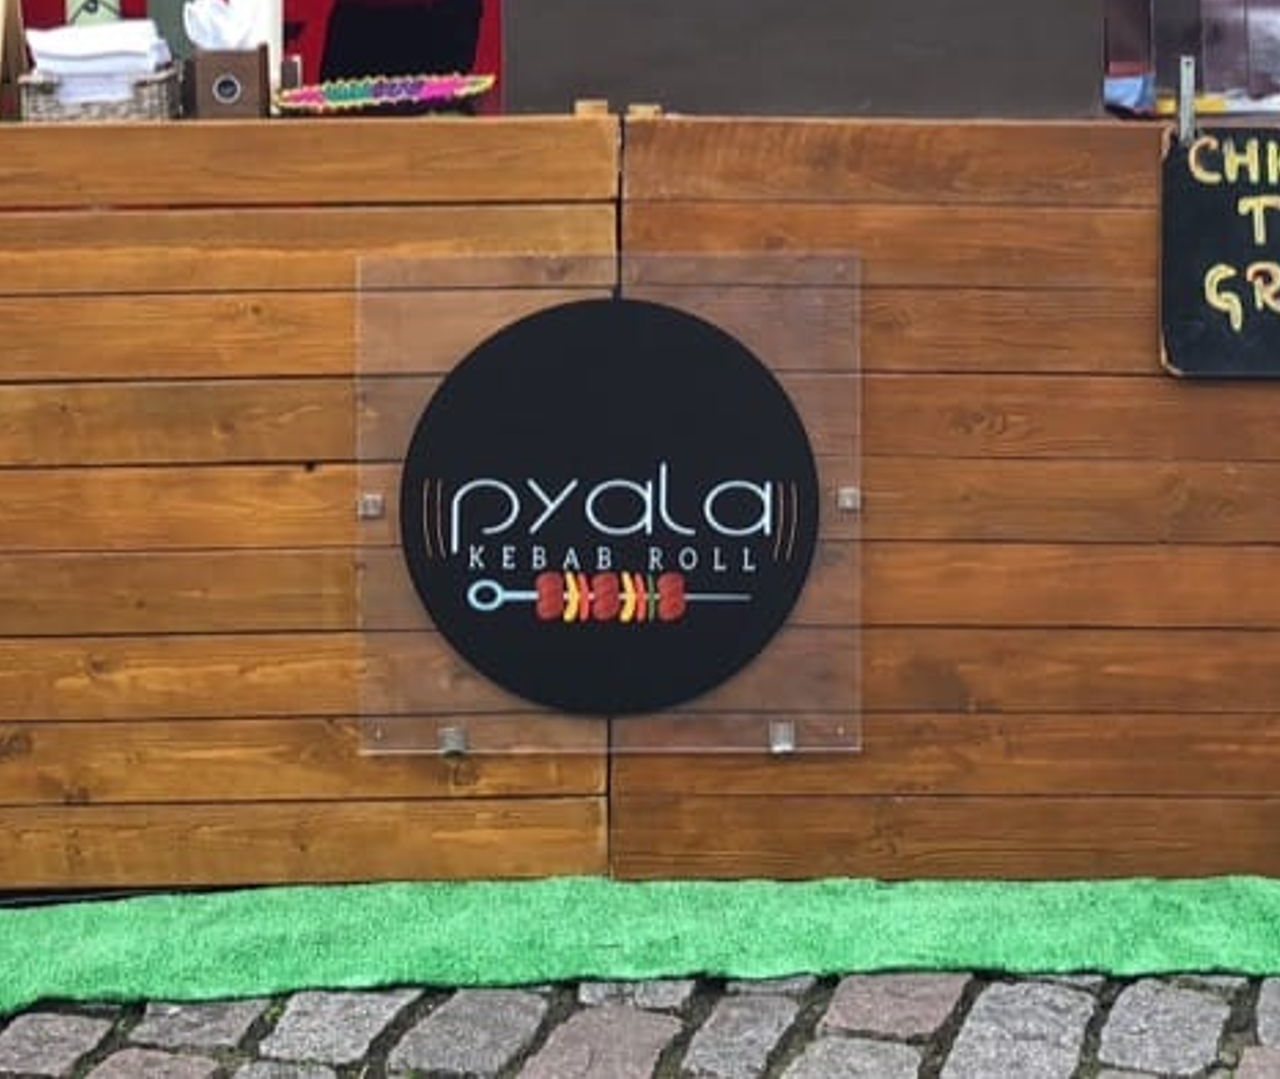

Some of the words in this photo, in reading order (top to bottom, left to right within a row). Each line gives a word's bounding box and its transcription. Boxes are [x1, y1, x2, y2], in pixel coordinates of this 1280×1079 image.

[451, 461, 771, 553] pyala
[469, 546, 612, 570] KEBAB
[649, 546, 757, 571] ROLL
